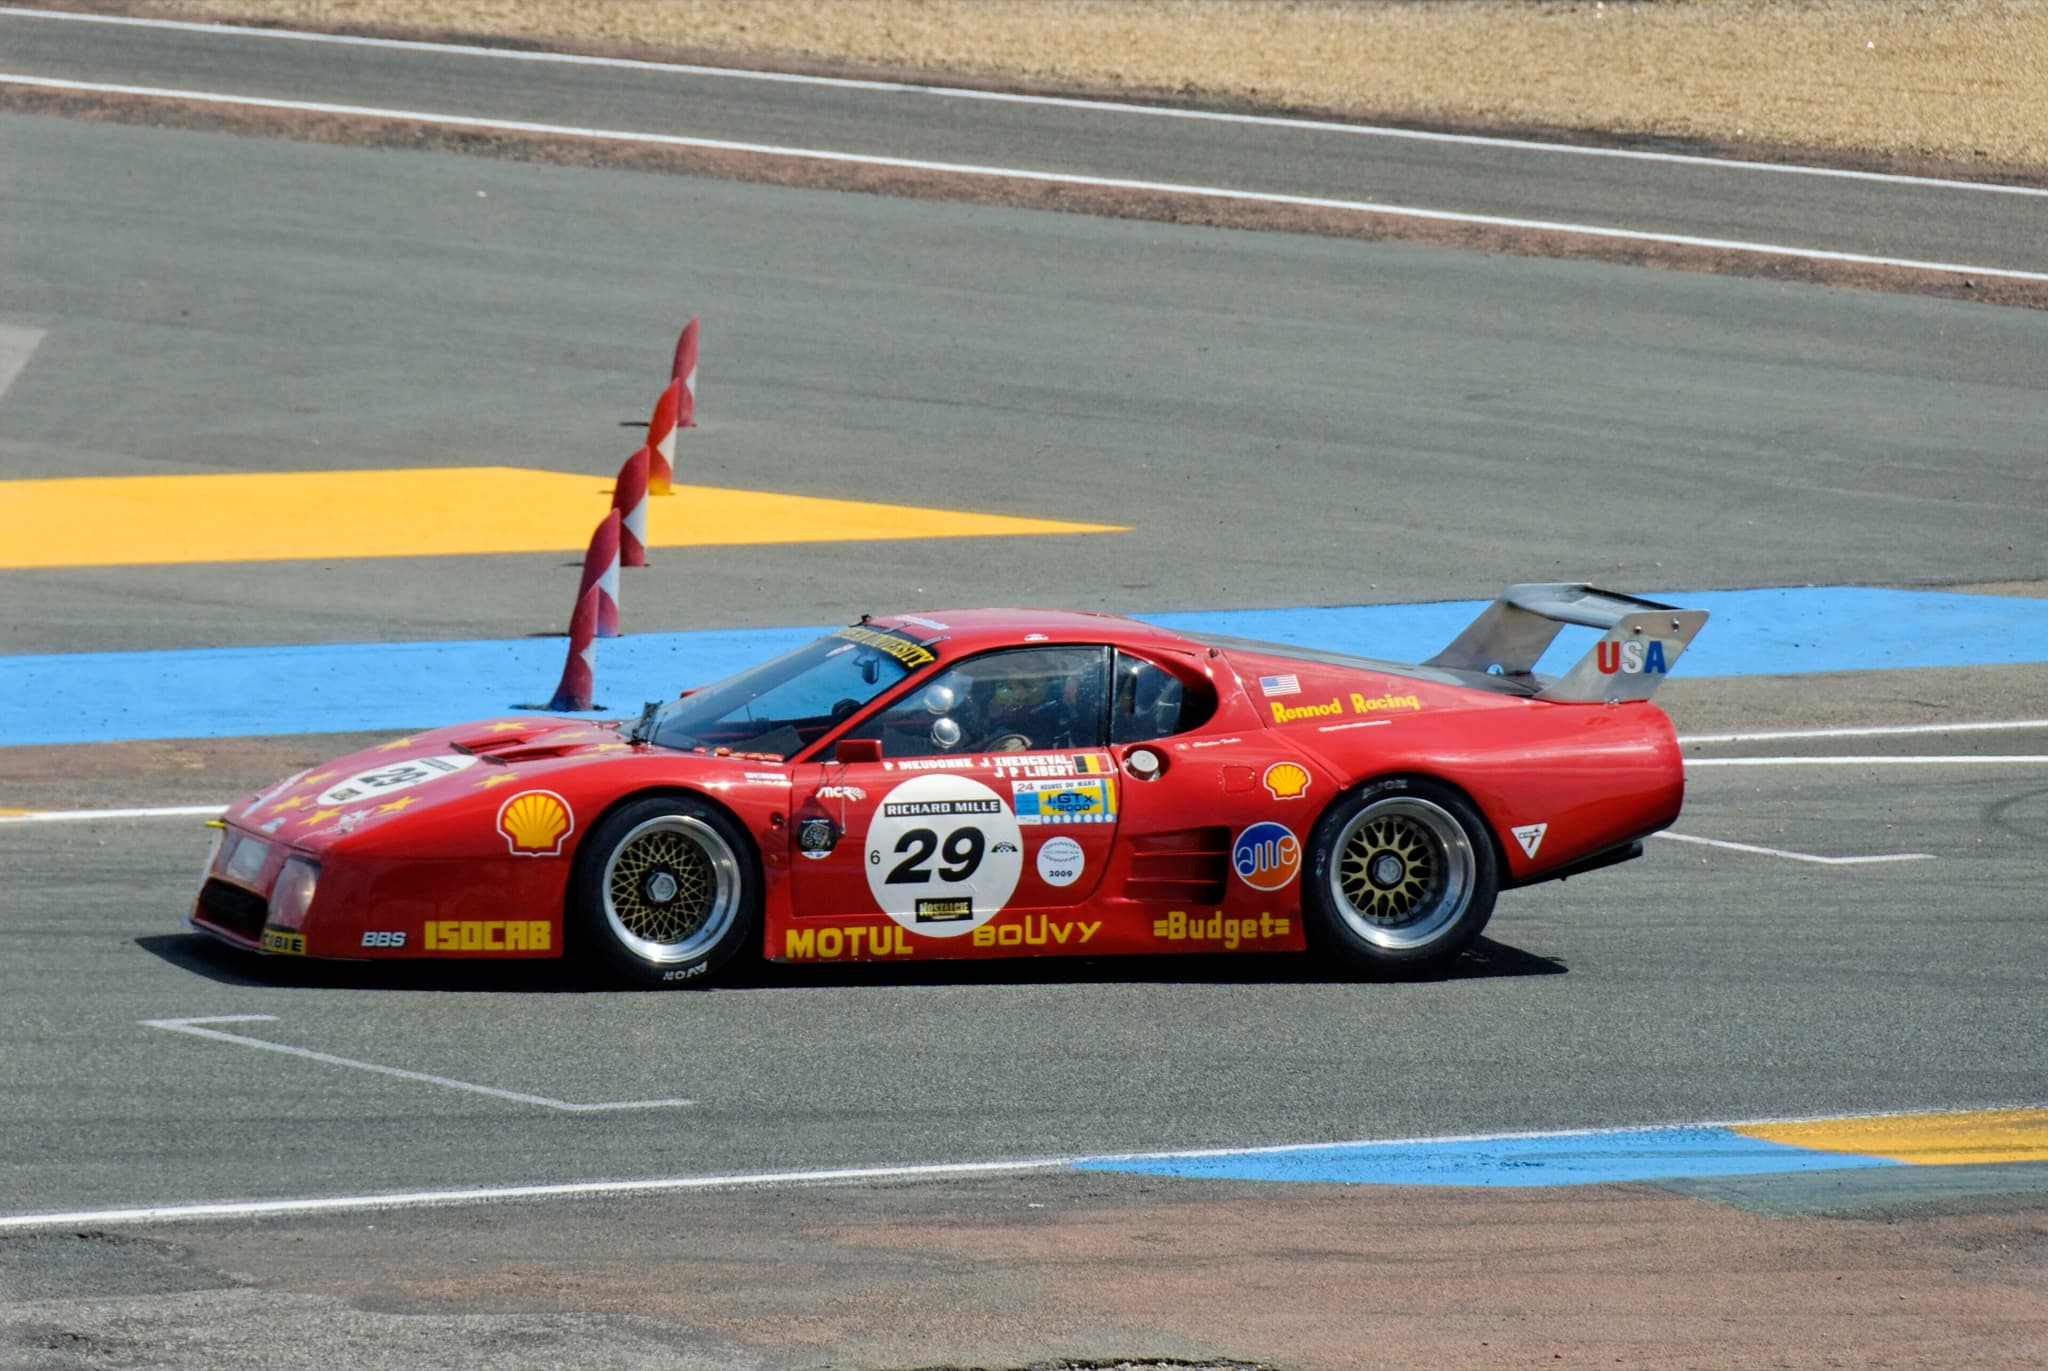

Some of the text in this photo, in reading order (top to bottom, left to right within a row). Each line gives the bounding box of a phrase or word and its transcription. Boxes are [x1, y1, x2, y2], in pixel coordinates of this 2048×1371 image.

[1597, 640, 1667, 675] USA
[1270, 693, 1421, 724] Rennod Racing
[883, 761, 894, 772] P
[899, 757, 974, 771] DIEUDONNE
[980, 756, 992, 768] J
[994, 765, 1074, 778] J P LIBERT
[358, 766, 428, 787] 29
[1017, 782, 1034, 792] 24
[886, 801, 999, 816] RICHARD MILLE
[870, 850, 881, 865] 6
[884, 826, 985, 884] 29
[361, 931, 407, 947] BBS
[424, 920, 551, 950] ISOCAB
[786, 925, 914, 959] MOTUL
[662, 960, 708, 981] AVON
